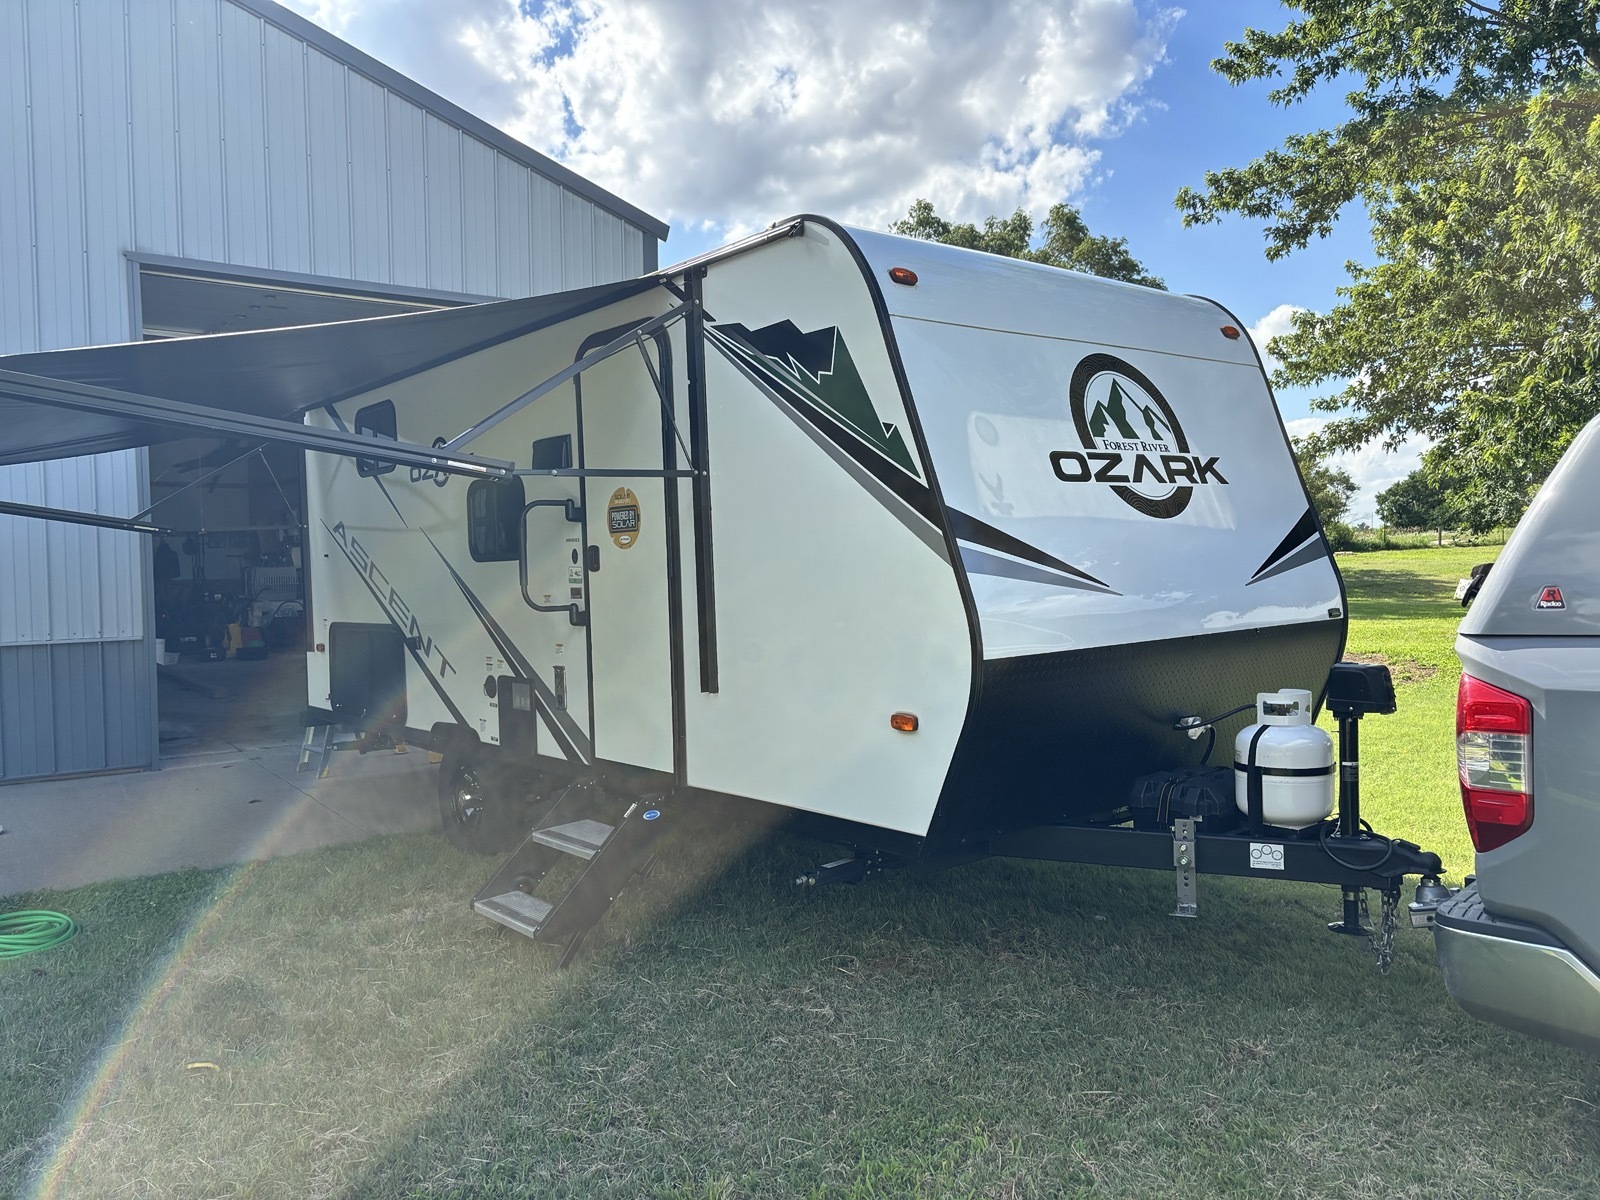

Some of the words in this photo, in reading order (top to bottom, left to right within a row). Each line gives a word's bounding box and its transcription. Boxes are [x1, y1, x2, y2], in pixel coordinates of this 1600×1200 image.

[1102, 440, 1139, 451] FOREST
[1140, 441, 1170, 452] RIVER
[1049, 450, 1229, 484] OZARK
[612, 520, 635, 529] SOLAR
[333, 521, 456, 678] ASCENT
